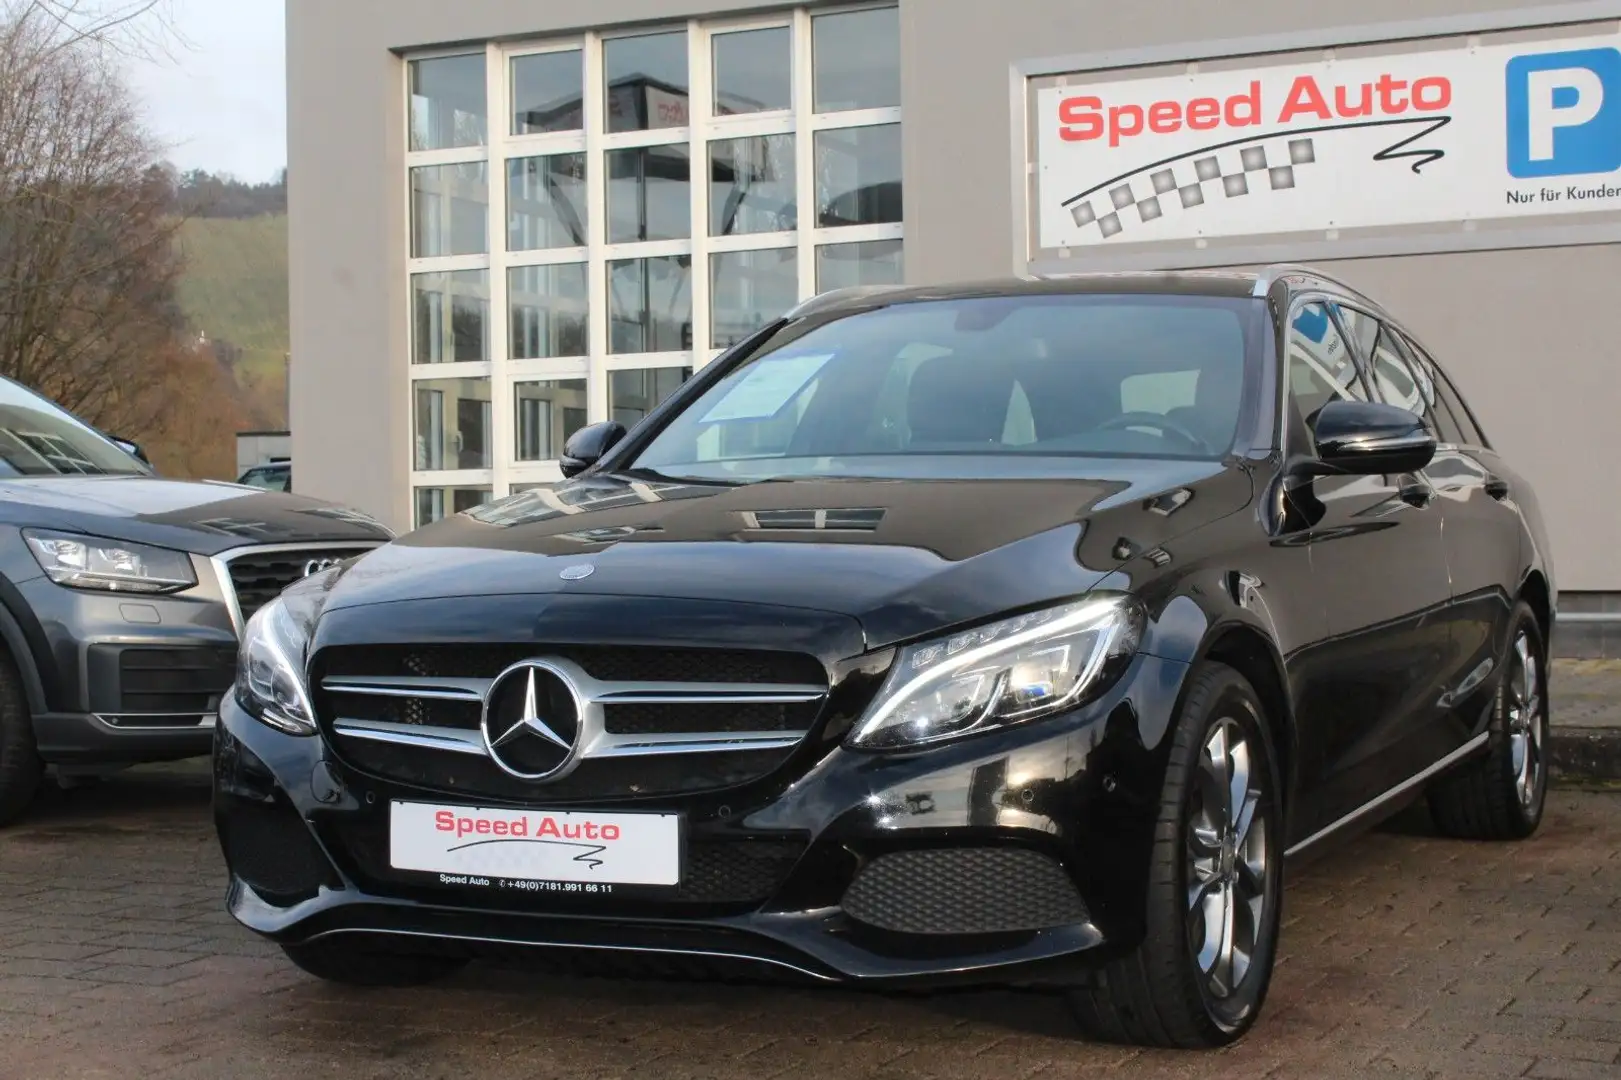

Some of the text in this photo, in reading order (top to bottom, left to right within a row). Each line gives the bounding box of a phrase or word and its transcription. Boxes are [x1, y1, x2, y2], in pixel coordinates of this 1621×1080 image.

[1058, 73, 1453, 148] Speed Auto
[1528, 67, 1604, 161] P
[1506, 189, 1536, 204] Nur
[1540, 187, 1562, 202] für
[435, 810, 621, 841] Speed Auto
[439, 873, 613, 893] Speed Auto +49(0)7181.991 66 11
